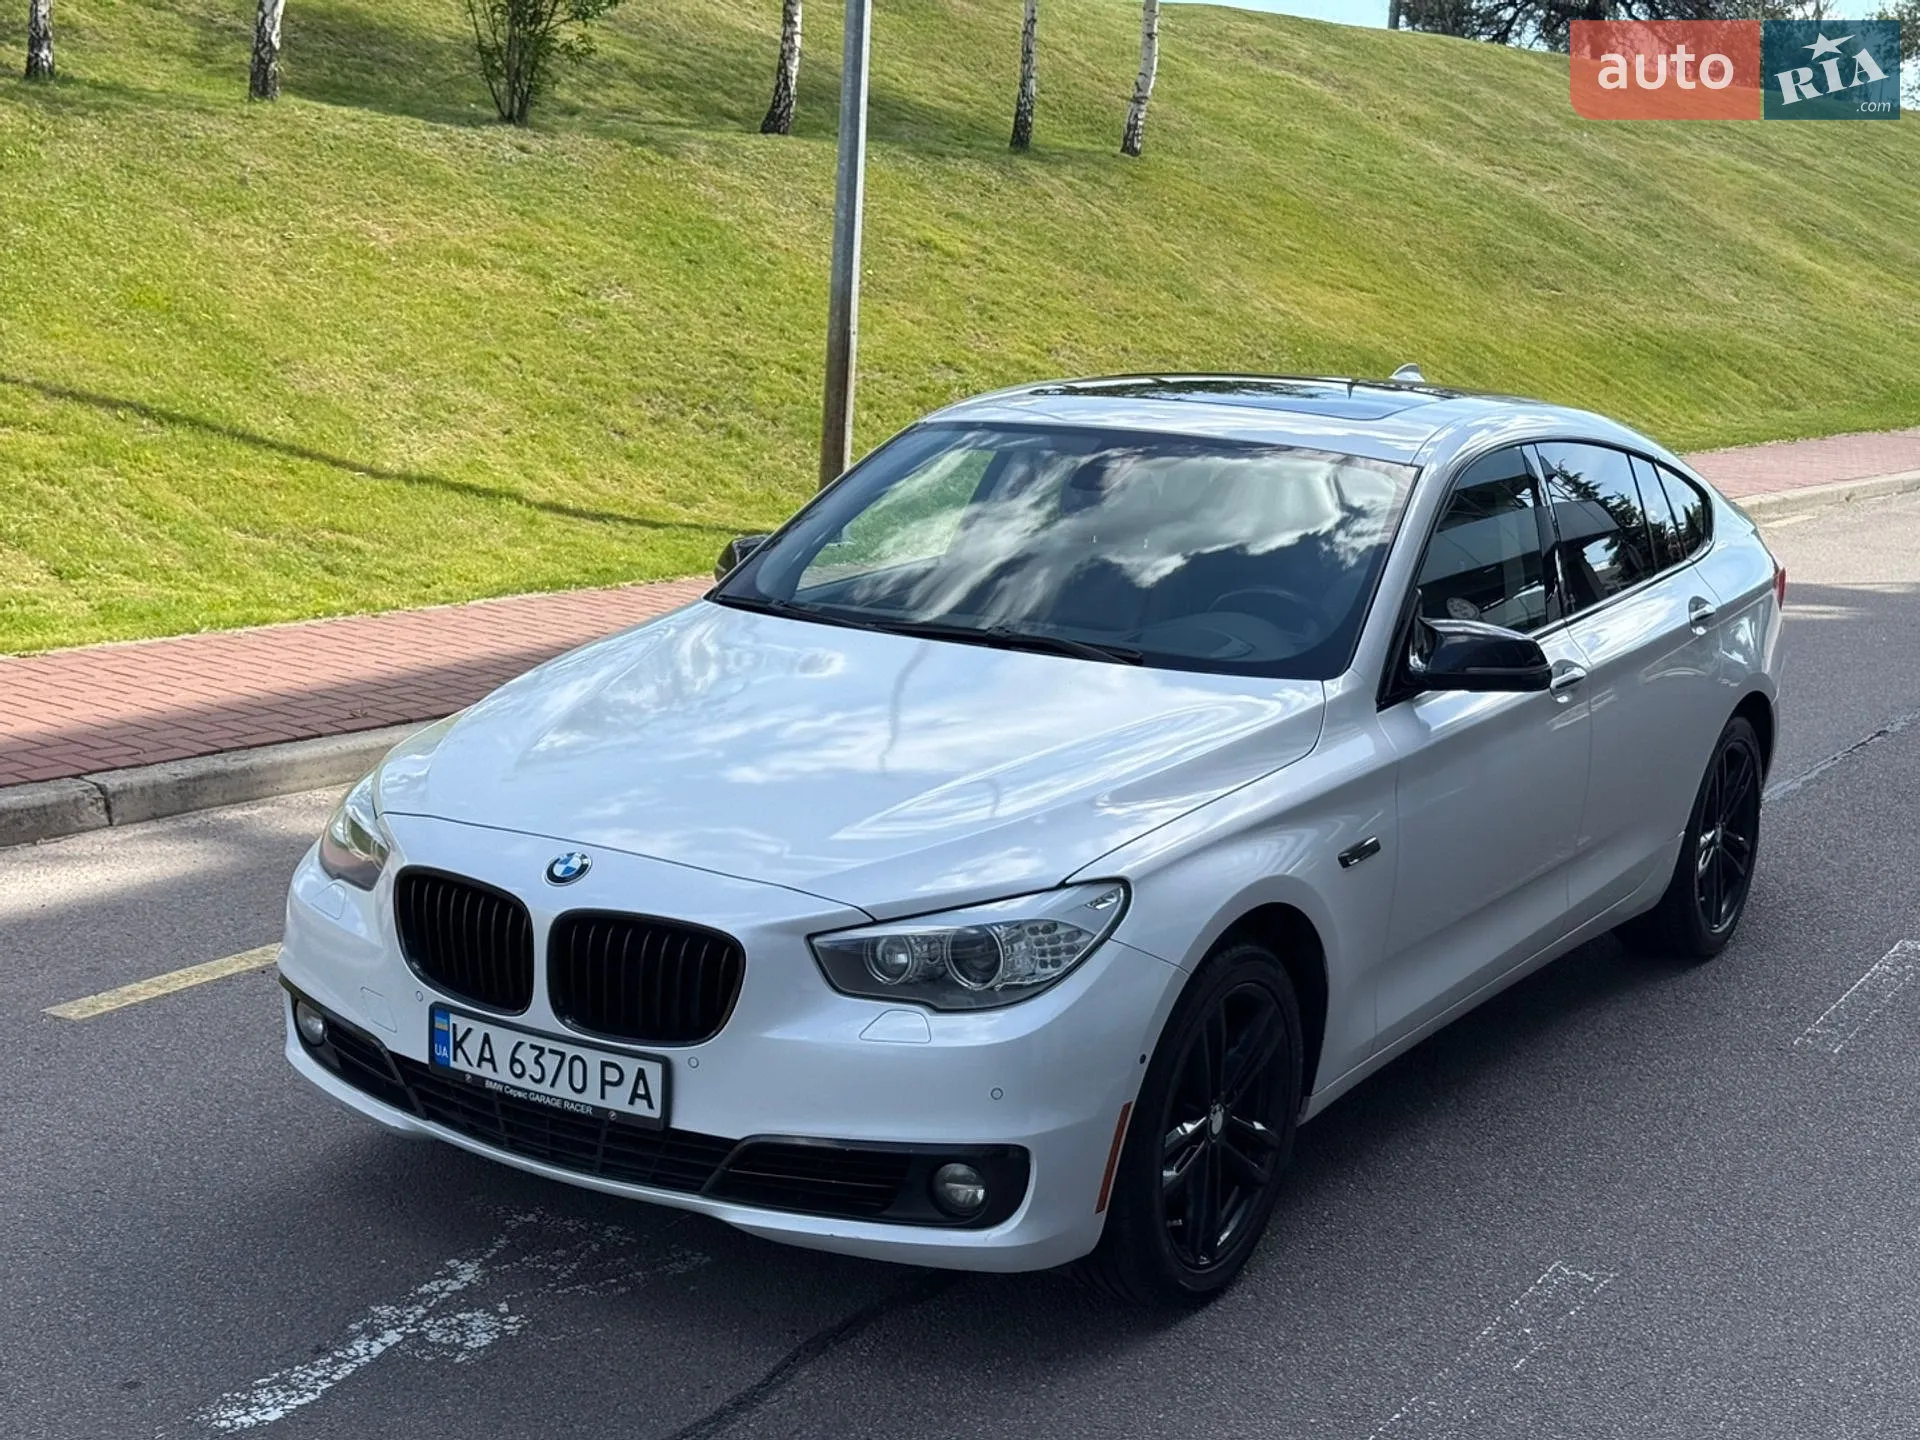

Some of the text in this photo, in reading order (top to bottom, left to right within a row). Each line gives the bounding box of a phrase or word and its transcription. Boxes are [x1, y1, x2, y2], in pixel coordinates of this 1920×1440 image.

[434, 1042, 449, 1058] UA
[452, 1022, 655, 1111] KA 6370 PA
[528, 1091, 562, 1109] GARAGE
[563, 1097, 592, 1115] RACER
